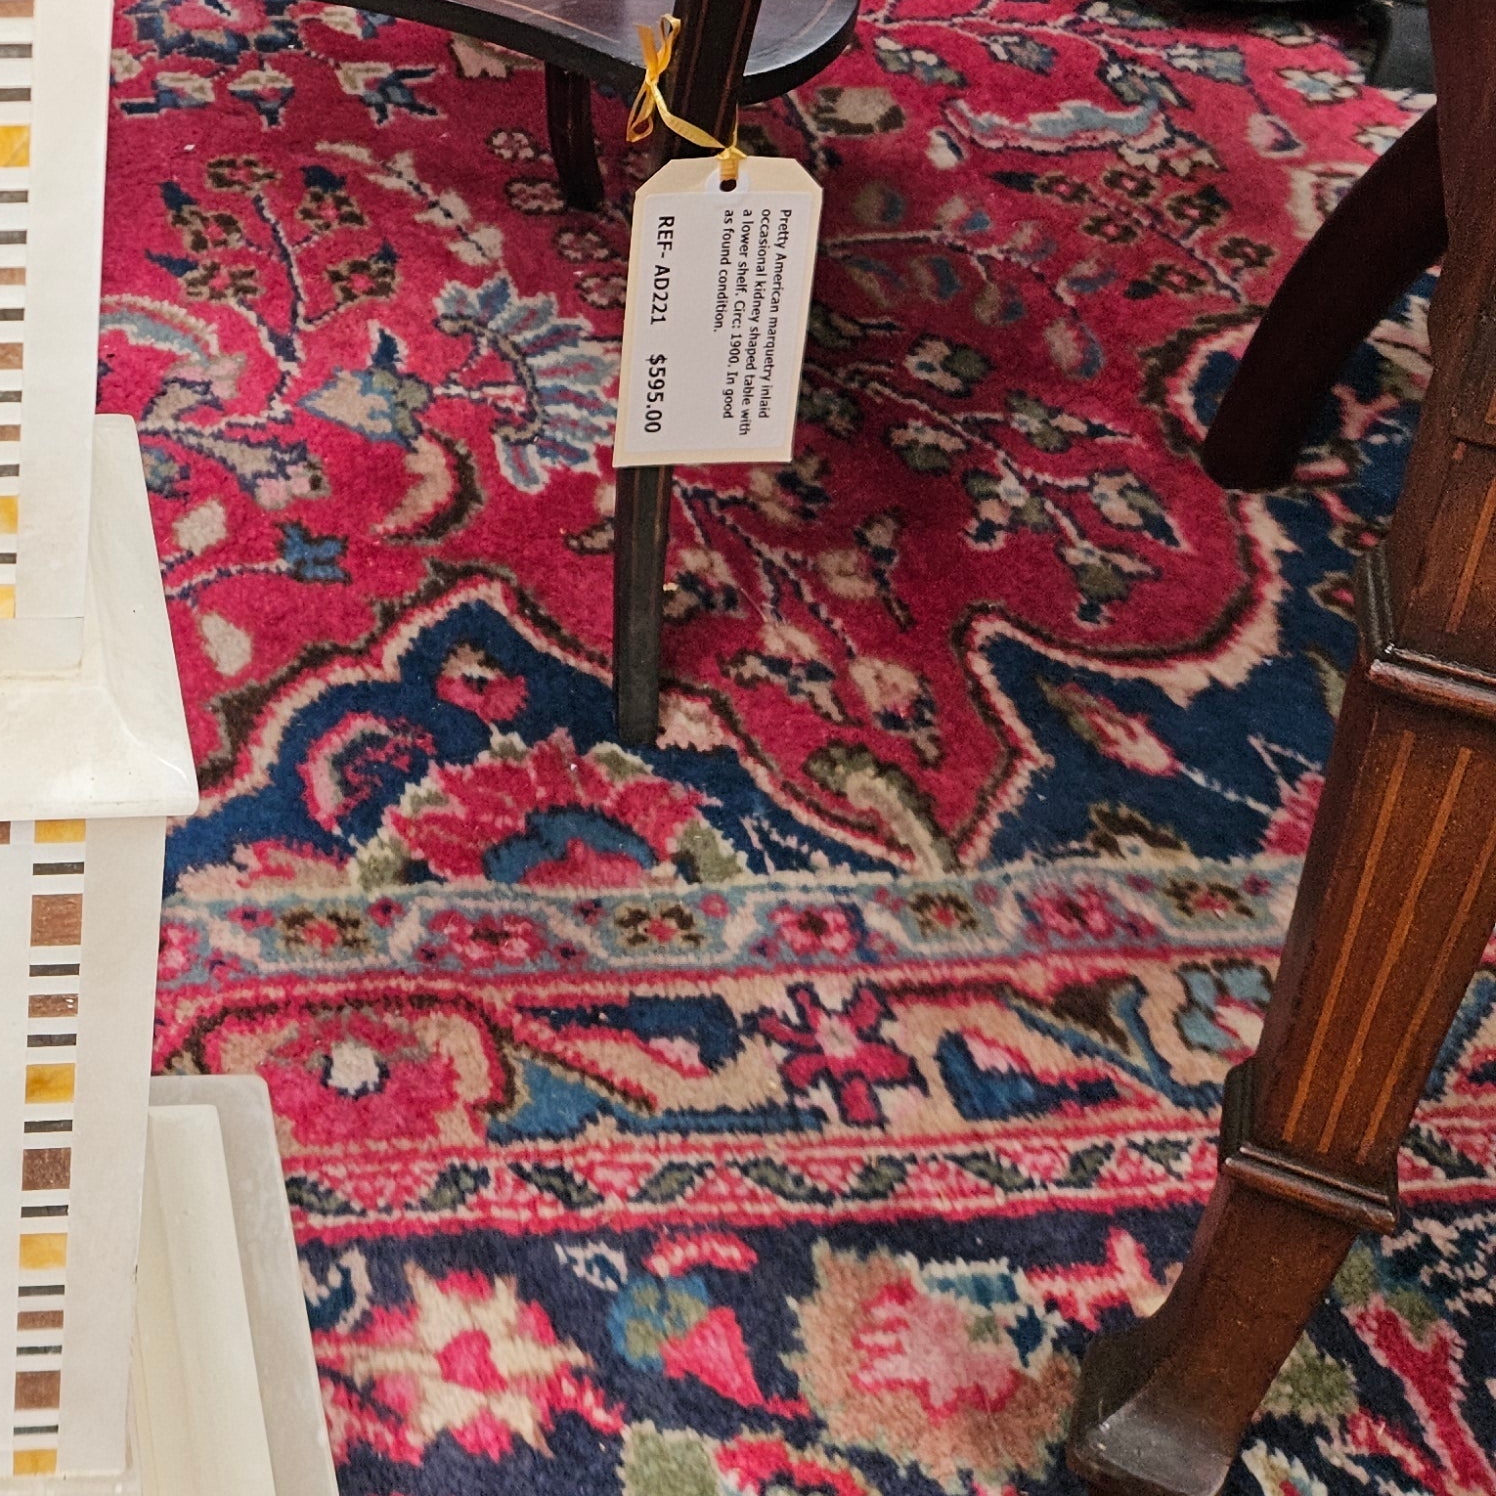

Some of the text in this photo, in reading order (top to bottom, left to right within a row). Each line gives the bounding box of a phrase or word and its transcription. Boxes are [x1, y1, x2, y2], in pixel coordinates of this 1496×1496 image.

[644, 216, 675, 434] REF- AD221 $595.00
[713, 209, 735, 333] as found condition.
[722, 209, 754, 419] a lower shelf. Circ: 1900. In good
[739, 209, 771, 436] occasional kidney shaped table with
[758, 209, 792, 419] Pretty American marquetry inlaid
